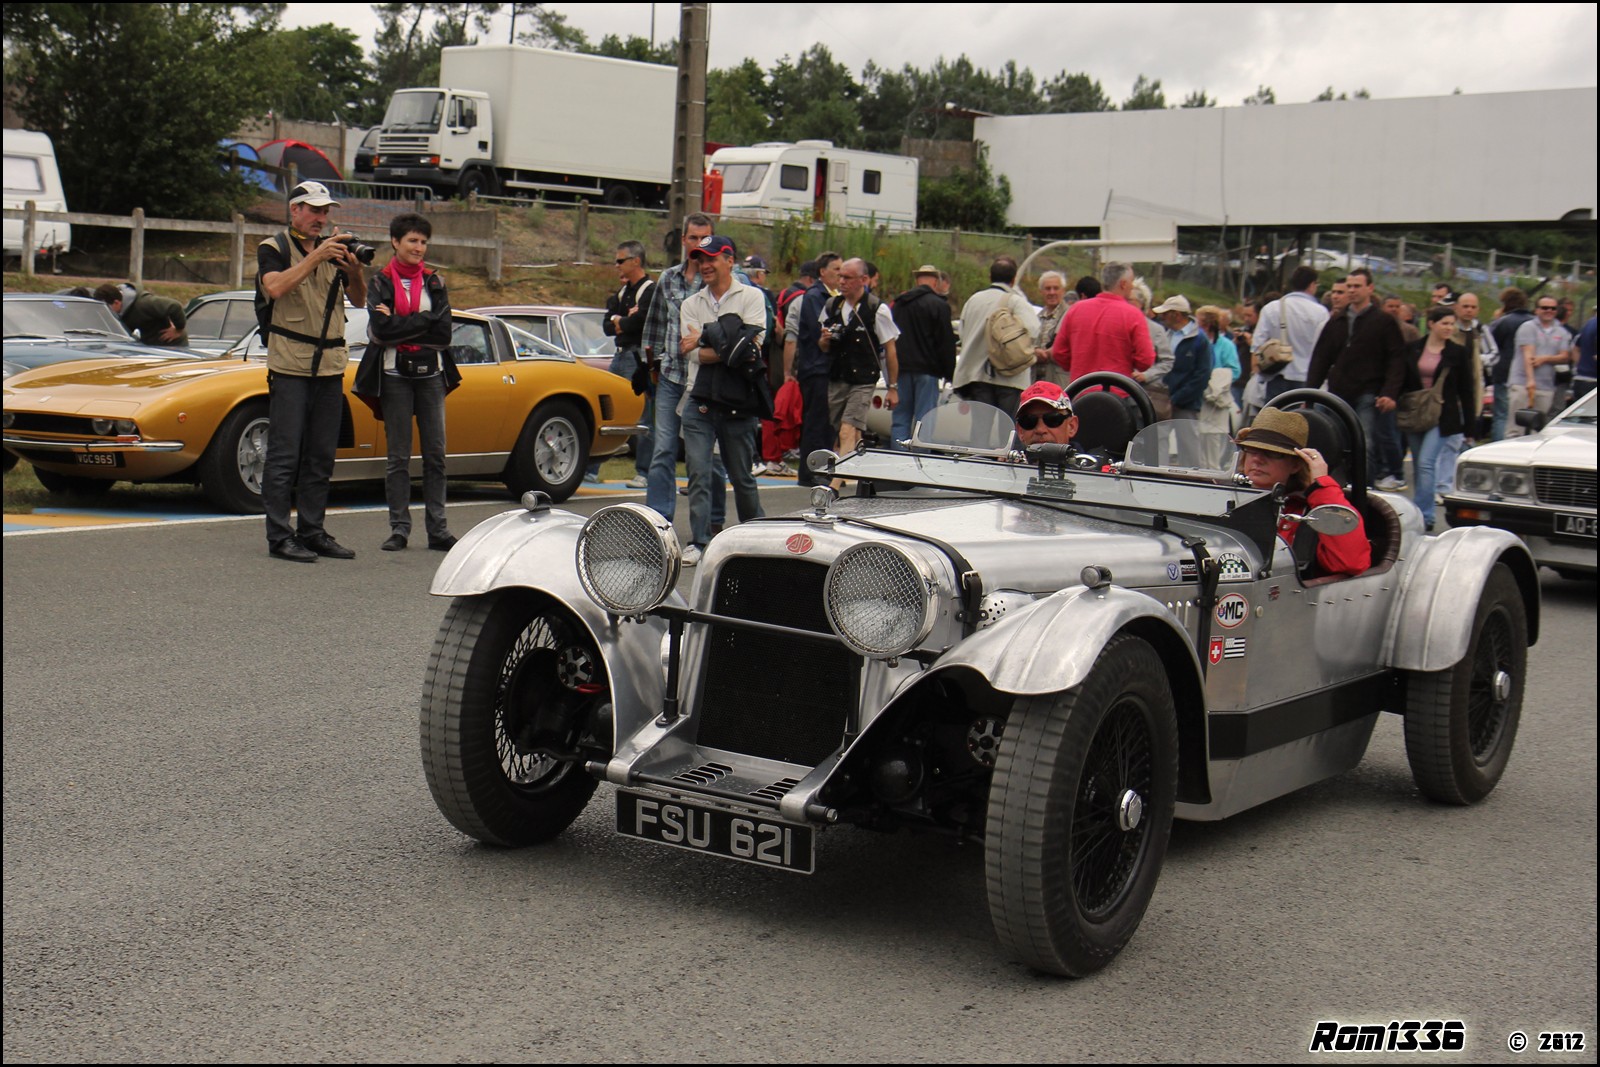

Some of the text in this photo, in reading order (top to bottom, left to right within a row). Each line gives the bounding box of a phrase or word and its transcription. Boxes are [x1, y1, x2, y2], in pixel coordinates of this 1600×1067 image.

[1225, 601, 1244, 620] MC
[636, 799, 792, 866] FSU 621
